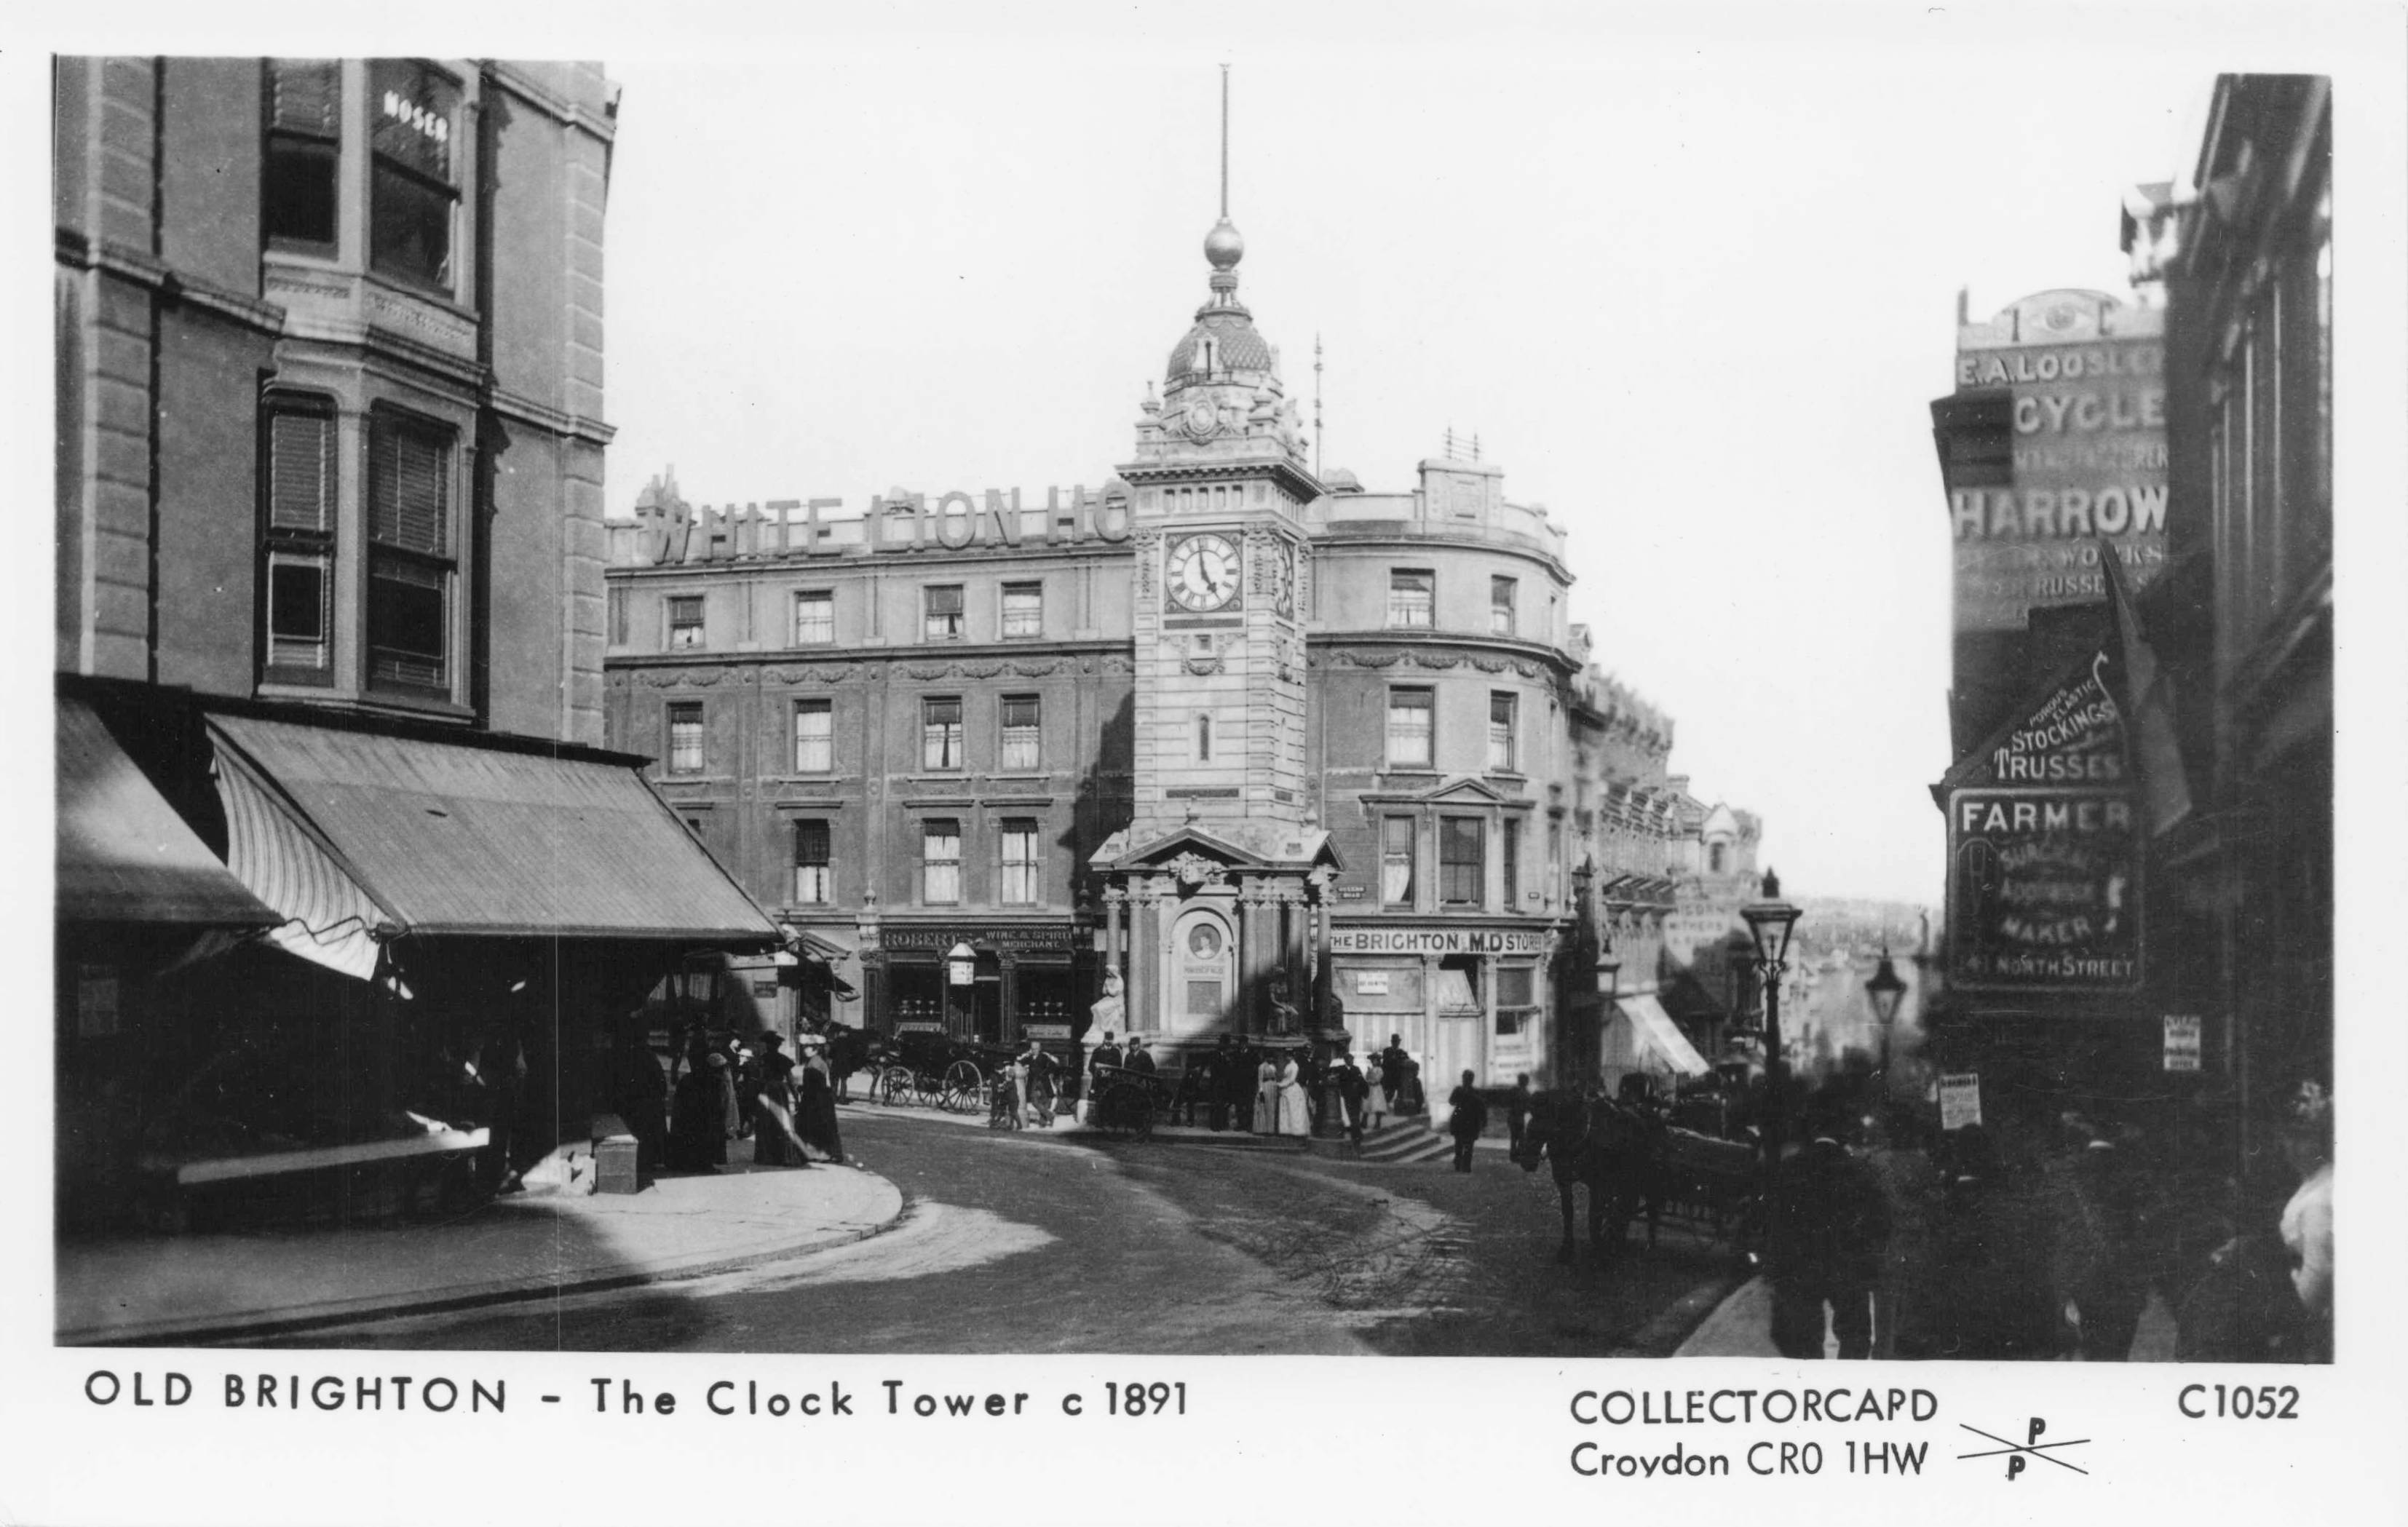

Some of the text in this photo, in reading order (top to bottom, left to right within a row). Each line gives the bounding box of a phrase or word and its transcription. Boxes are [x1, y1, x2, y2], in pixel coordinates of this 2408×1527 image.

[648, 496, 842, 565] WHITE
[872, 487, 1021, 553] LION
[1952, 485, 2169, 539] HARROW
[2052, 679, 2096, 721] ELASTIC
[2011, 700, 2116, 754] STOCKINGS
[1993, 747, 2121, 780] TRUSSES
[1963, 801, 2131, 833] FARMER
[986, 930, 1018, 940] WINE
[1033, 929, 1072, 940] SPIRIT
[1355, 932, 1459, 950] BRIGHTON
[2003, 915, 2092, 944] MAKER
[2062, 954, 2134, 977] STREET
